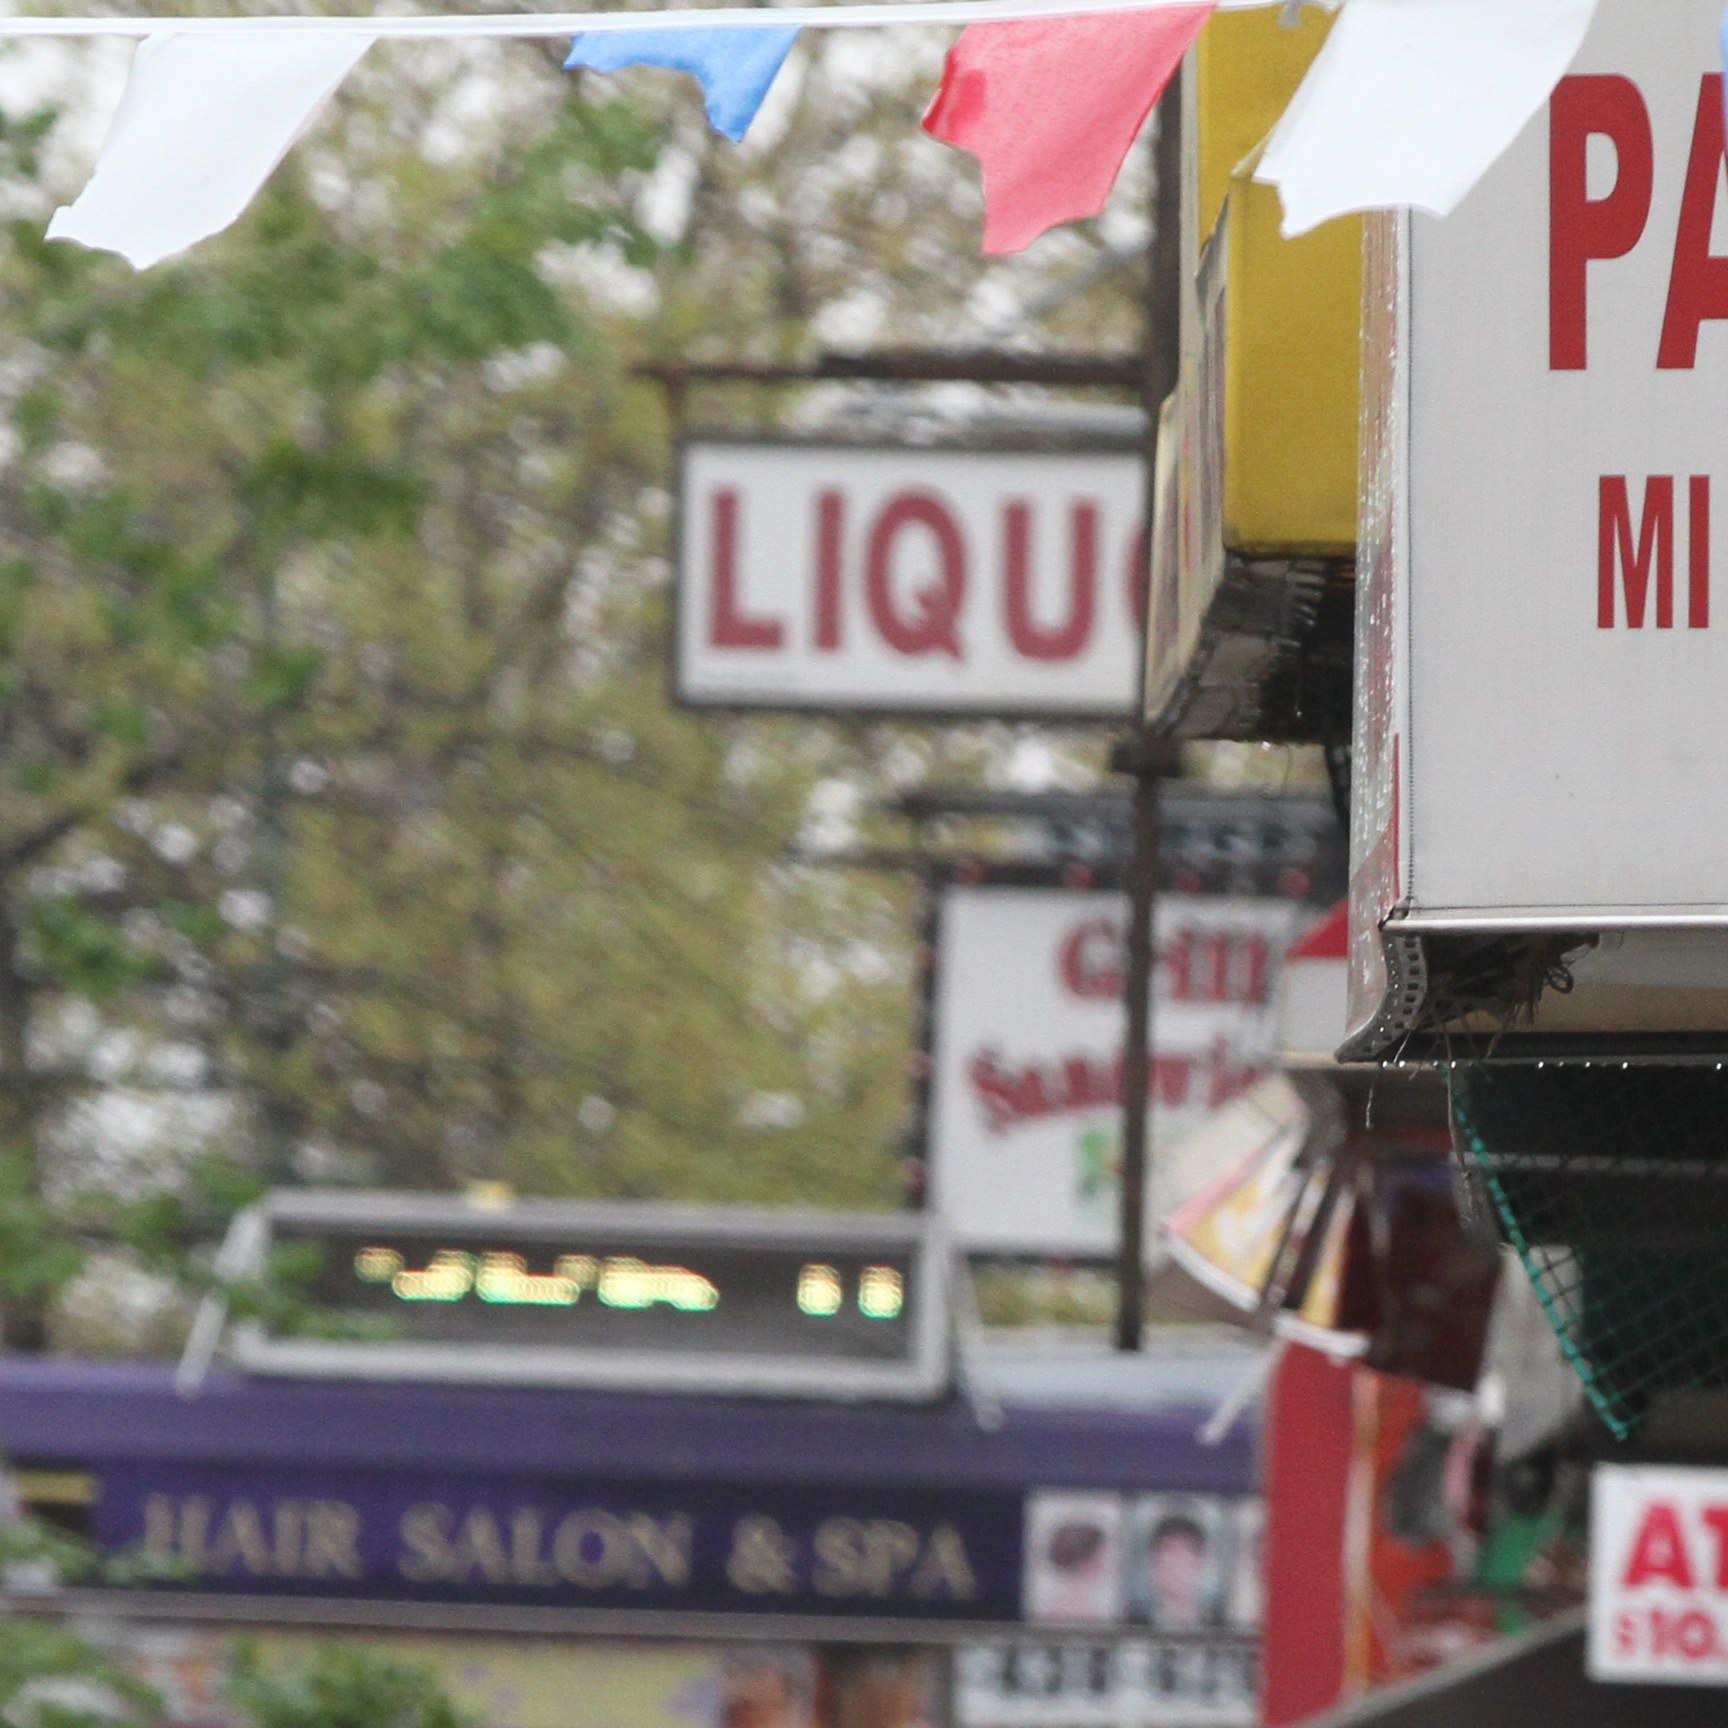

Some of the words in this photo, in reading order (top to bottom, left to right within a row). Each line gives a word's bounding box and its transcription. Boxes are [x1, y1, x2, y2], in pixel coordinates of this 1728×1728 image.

[707, 486, 1146, 664] LIQU
[1596, 474, 1711, 630] MI
[138, 1493, 367, 1582] HAIR
[396, 1500, 693, 1591] SALON
[726, 1512, 798, 1596] &
[811, 1514, 978, 1600] SPA
